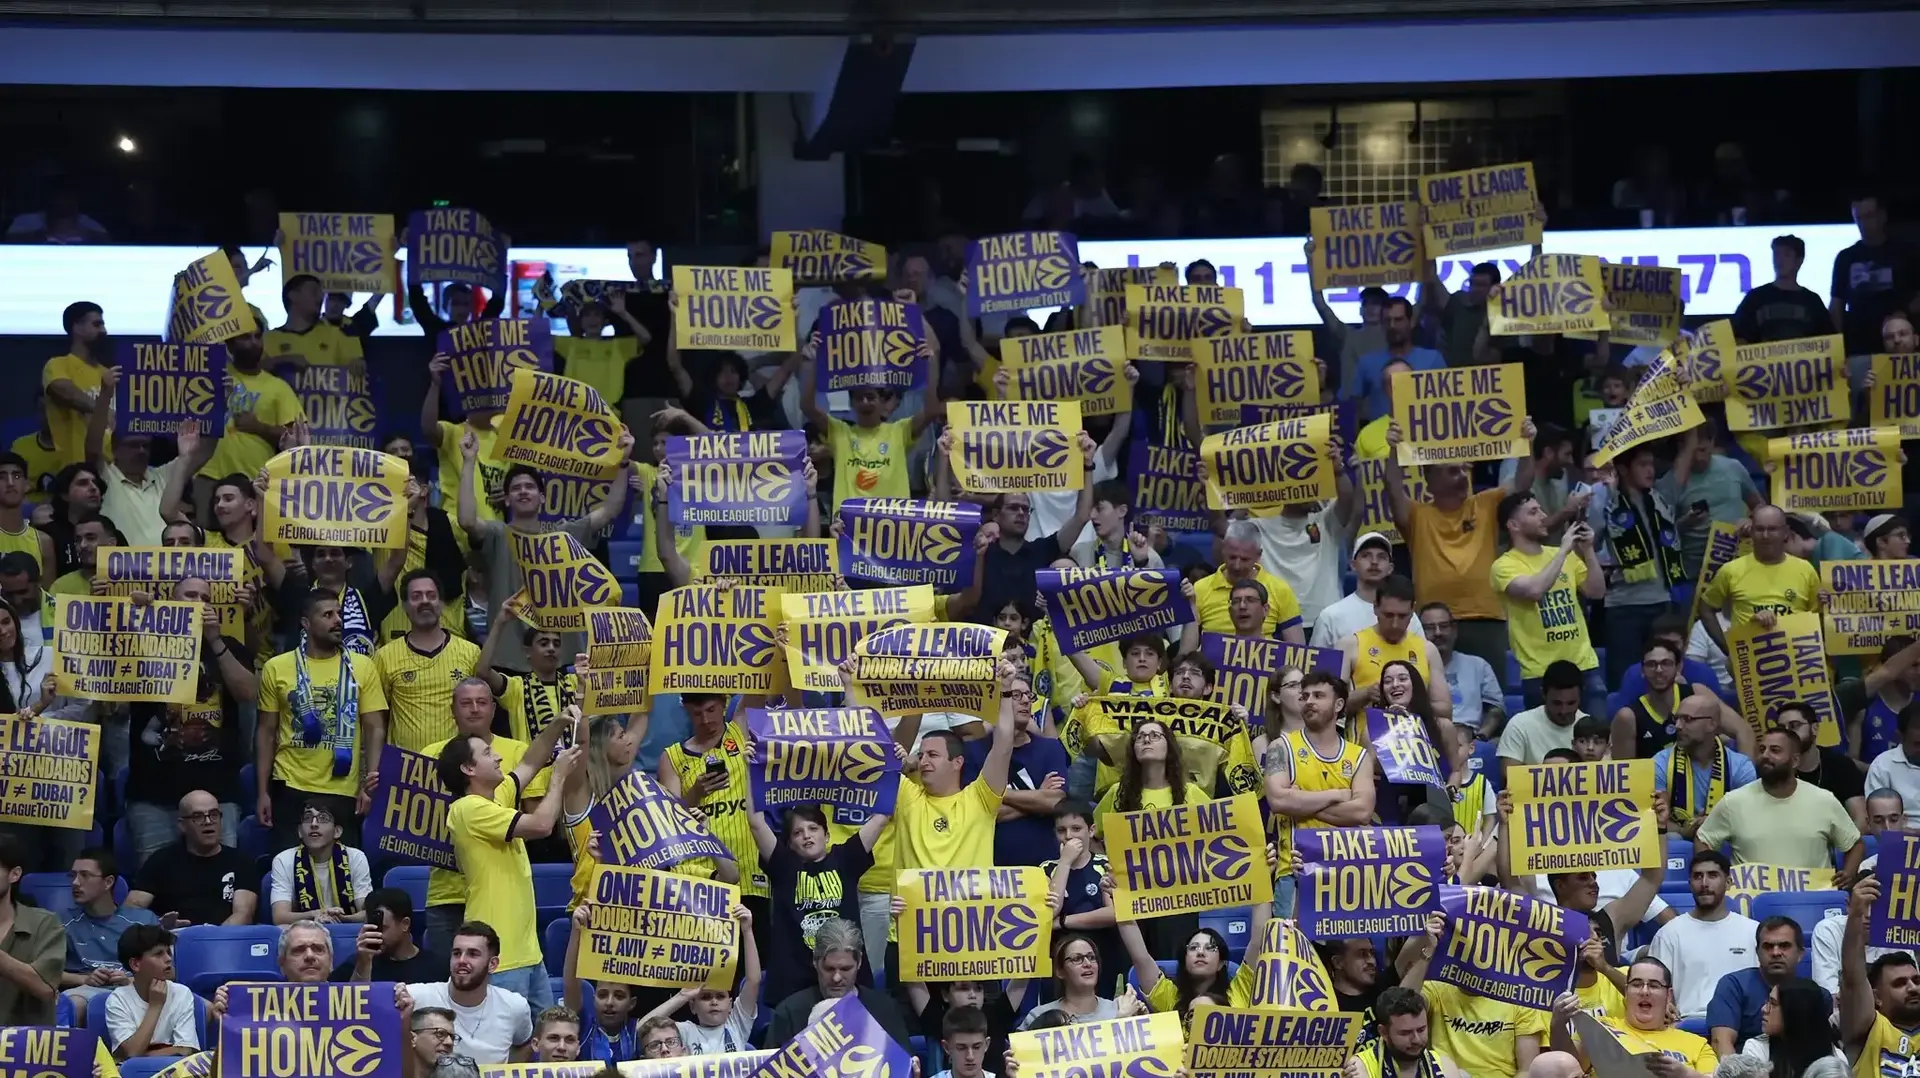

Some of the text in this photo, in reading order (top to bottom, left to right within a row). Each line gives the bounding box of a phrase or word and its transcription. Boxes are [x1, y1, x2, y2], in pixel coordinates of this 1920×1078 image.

[1428, 168, 1528, 203] ONE LEAGUE
[296, 215, 374, 237] TAKE ME
[1328, 206, 1375, 231] TAKE
[1380, 204, 1408, 228] ME
[789, 232, 864, 252] TAKE ME
[979, 232, 1059, 260] TAKE ME
[690, 269, 772, 292] TAKE ME
[1557, 256, 1584, 278] ME
[1144, 286, 1224, 303] TAKE ME
[831, 304, 907, 330] TAKE ME
[449, 320, 530, 349] TAKE ME
[1019, 330, 1103, 363] TAKE ME
[1209, 334, 1296, 362] TAKE ME
[134, 344, 209, 372] TAKE ME
[346, 371, 370, 396] ME
[532, 374, 610, 416] TAKE ME
[1412, 368, 1502, 400] TAKE ME
[967, 403, 1059, 426] TAKE ME
[1748, 398, 1833, 427] TAKE ME
[686, 433, 782, 459] TAKE ME
[1222, 418, 1306, 447] TAKE ME
[1790, 428, 1877, 449] TAKE ME
[288, 448, 385, 478] TAKE ME
[1148, 446, 1196, 478] TAKE
[864, 498, 959, 521] TAKE ME
[512, 534, 564, 565] TAKE
[710, 543, 832, 574] ONE LEAGUE
[108, 551, 234, 581] ONE LEAGUE
[1832, 565, 1874, 591] ONE
[672, 587, 767, 619] TAKE ME
[804, 590, 910, 618] TAKE ME
[66, 600, 195, 636] ONE LEAGUE
[591, 613, 615, 644] ONE
[1834, 616, 1884, 633] TEL AVIV
[62, 632, 194, 660] DOUBLE STANDARDS
[865, 627, 993, 657] ONE LEAGUE
[1222, 637, 1320, 675] TAKE ME
[62, 656, 192, 681] TEL AVIV DUBAI ?
[860, 658, 994, 681] DOUBLE STANDARDS
[1791, 630, 1825, 687] TAKE
[533, 685, 555, 725] AVIV
[862, 682, 995, 700] TEL AVIV DUBAI ?
[767, 708, 876, 736] TAKE ME
[1170, 719, 1242, 743] AVIV
[10, 721, 90, 759] LEAGUE
[8, 754, 90, 783] STANDARDS
[1529, 763, 1630, 798] TAKE ME
[32, 782, 87, 804] DUBAI ?
[601, 770, 656, 821] TAKE
[1125, 800, 1237, 843] TAKE ME
[1316, 828, 1421, 861] TAKE ME
[919, 869, 1026, 902] TAKE ME
[1777, 868, 1811, 892] ME
[596, 871, 731, 919] ONE LEAGUE
[591, 907, 732, 944] DOUBLE STANDARDS
[1463, 887, 1564, 937] TAKE ME
[591, 934, 730, 967] TEL AVIV DUBAI ?
[247, 985, 370, 1022] TAKE ME
[807, 1011, 855, 1060] ME
[1034, 1018, 1156, 1066] TAKE ME
[1203, 1013, 1352, 1046] ONE LEAGUE
[25, 1029, 70, 1066] ME
[1195, 1046, 1346, 1068] DOUBLE STANDARDS
